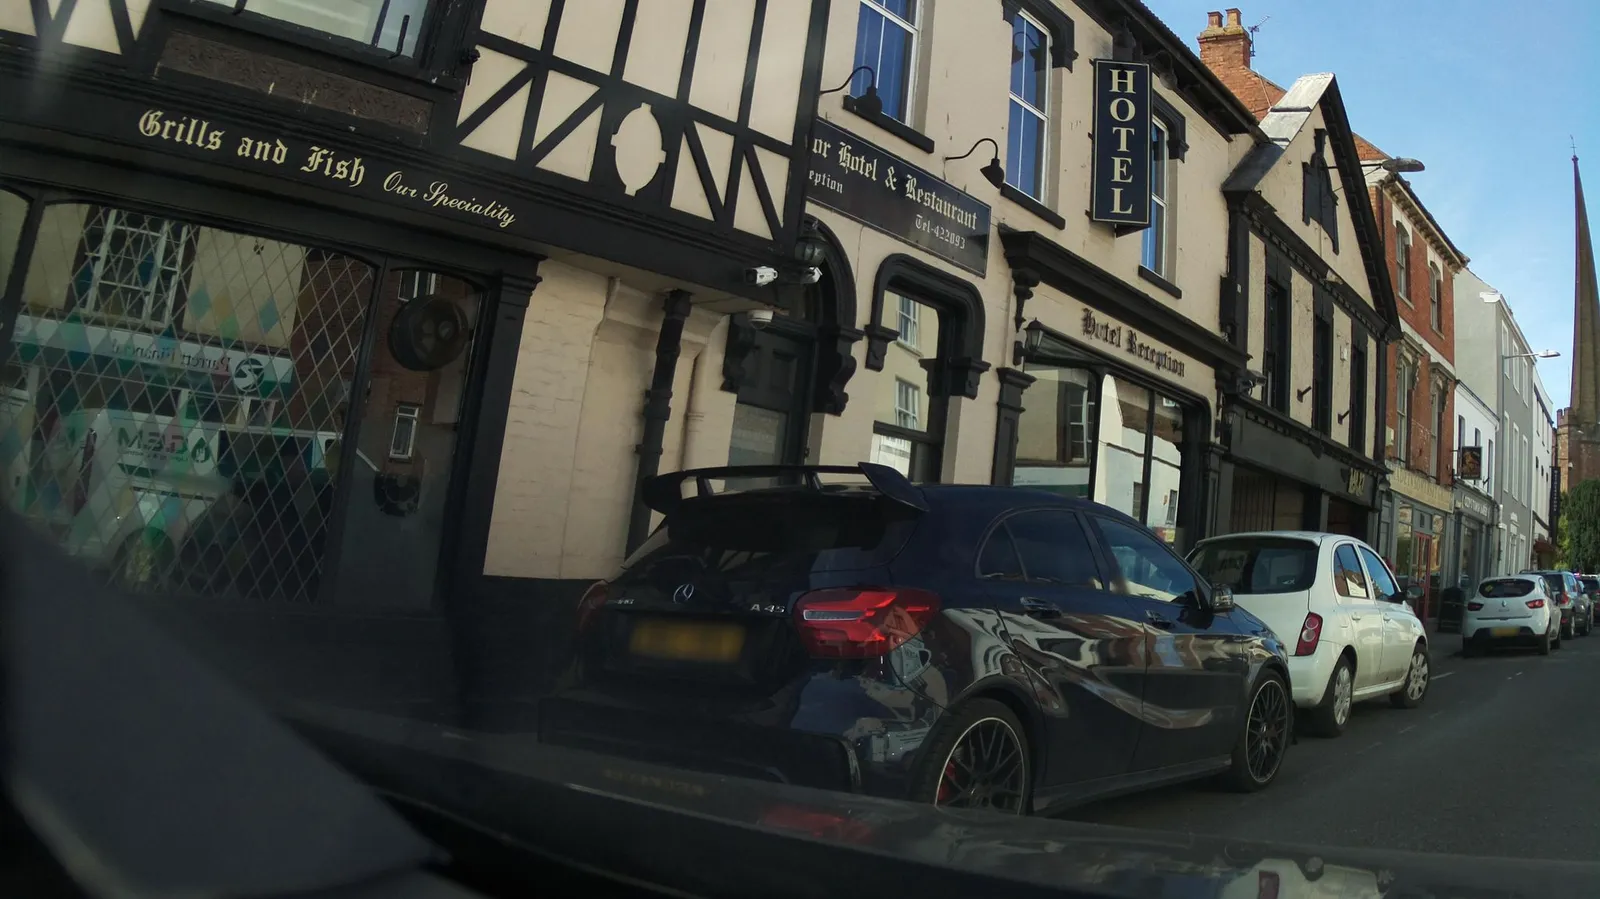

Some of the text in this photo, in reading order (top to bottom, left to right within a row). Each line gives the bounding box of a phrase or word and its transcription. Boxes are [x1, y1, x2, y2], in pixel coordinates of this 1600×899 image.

[138, 109, 365, 188] Grills and Fish
[1109, 68, 1137, 214] HOTEL
[383, 170, 516, 228] Our Speciality
[838, 141, 878, 181] Hotel
[884, 165, 897, 191] &
[905, 174, 978, 230] Restaurant
[1081, 307, 1185, 377] Hotel Reception
